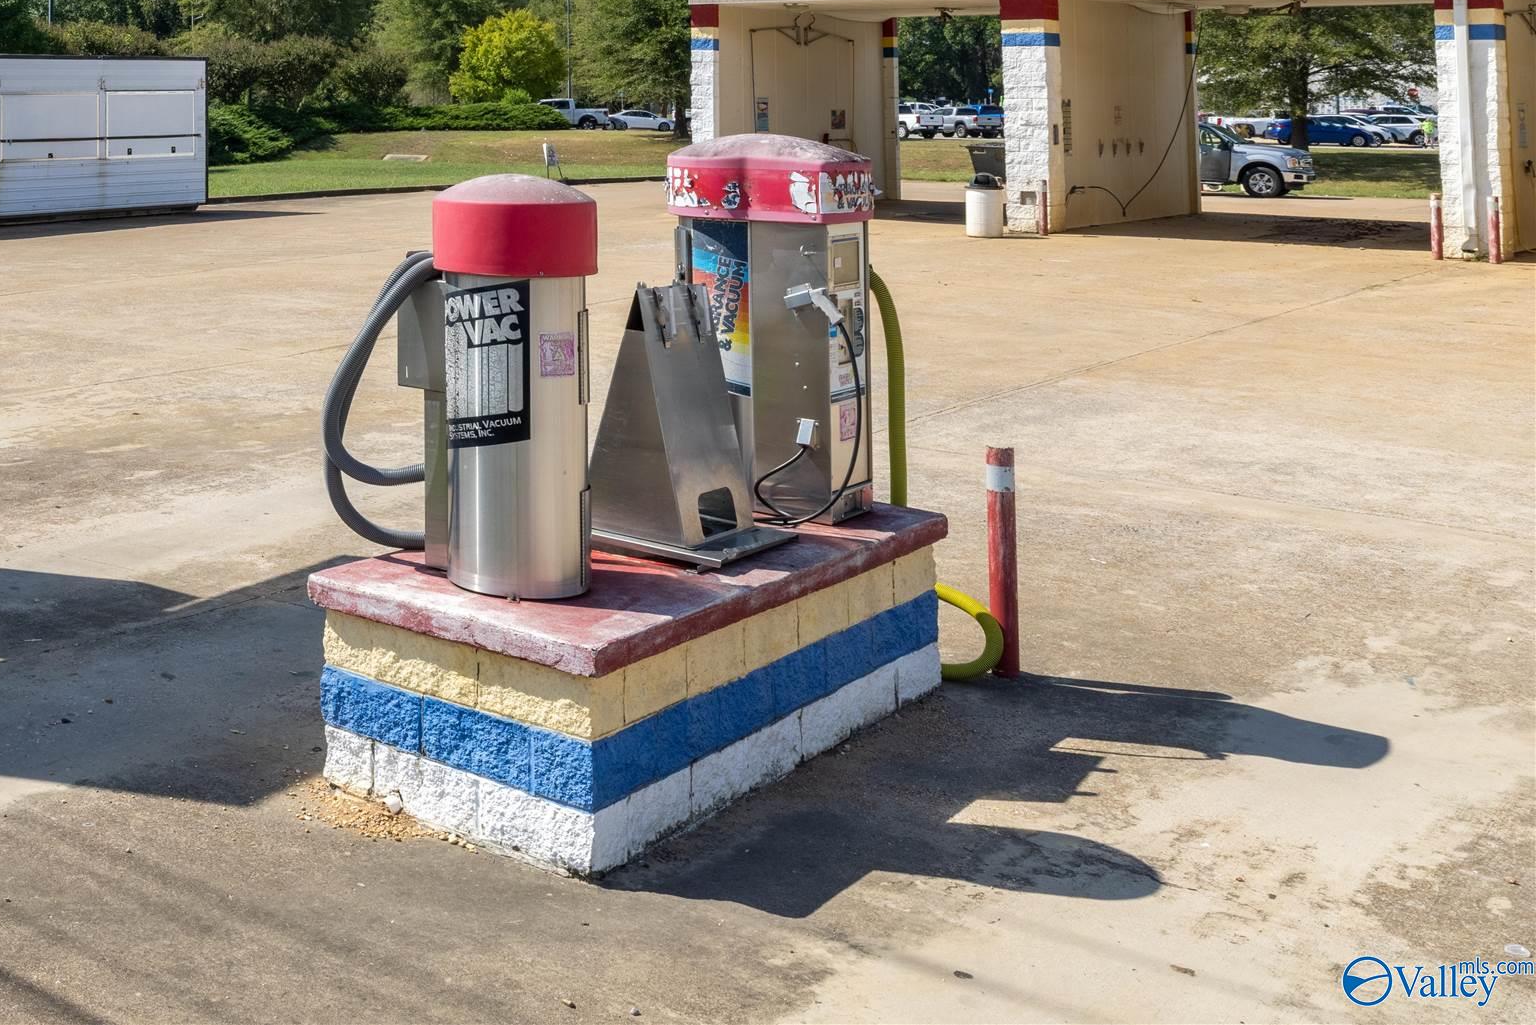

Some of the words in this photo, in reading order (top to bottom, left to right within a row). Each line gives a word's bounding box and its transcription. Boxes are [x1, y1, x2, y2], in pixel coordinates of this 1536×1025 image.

[445, 288, 525, 324] OWER
[721, 261, 747, 334] VACUUM
[465, 314, 522, 345] VAC
[482, 416, 522, 428] VACUUM
